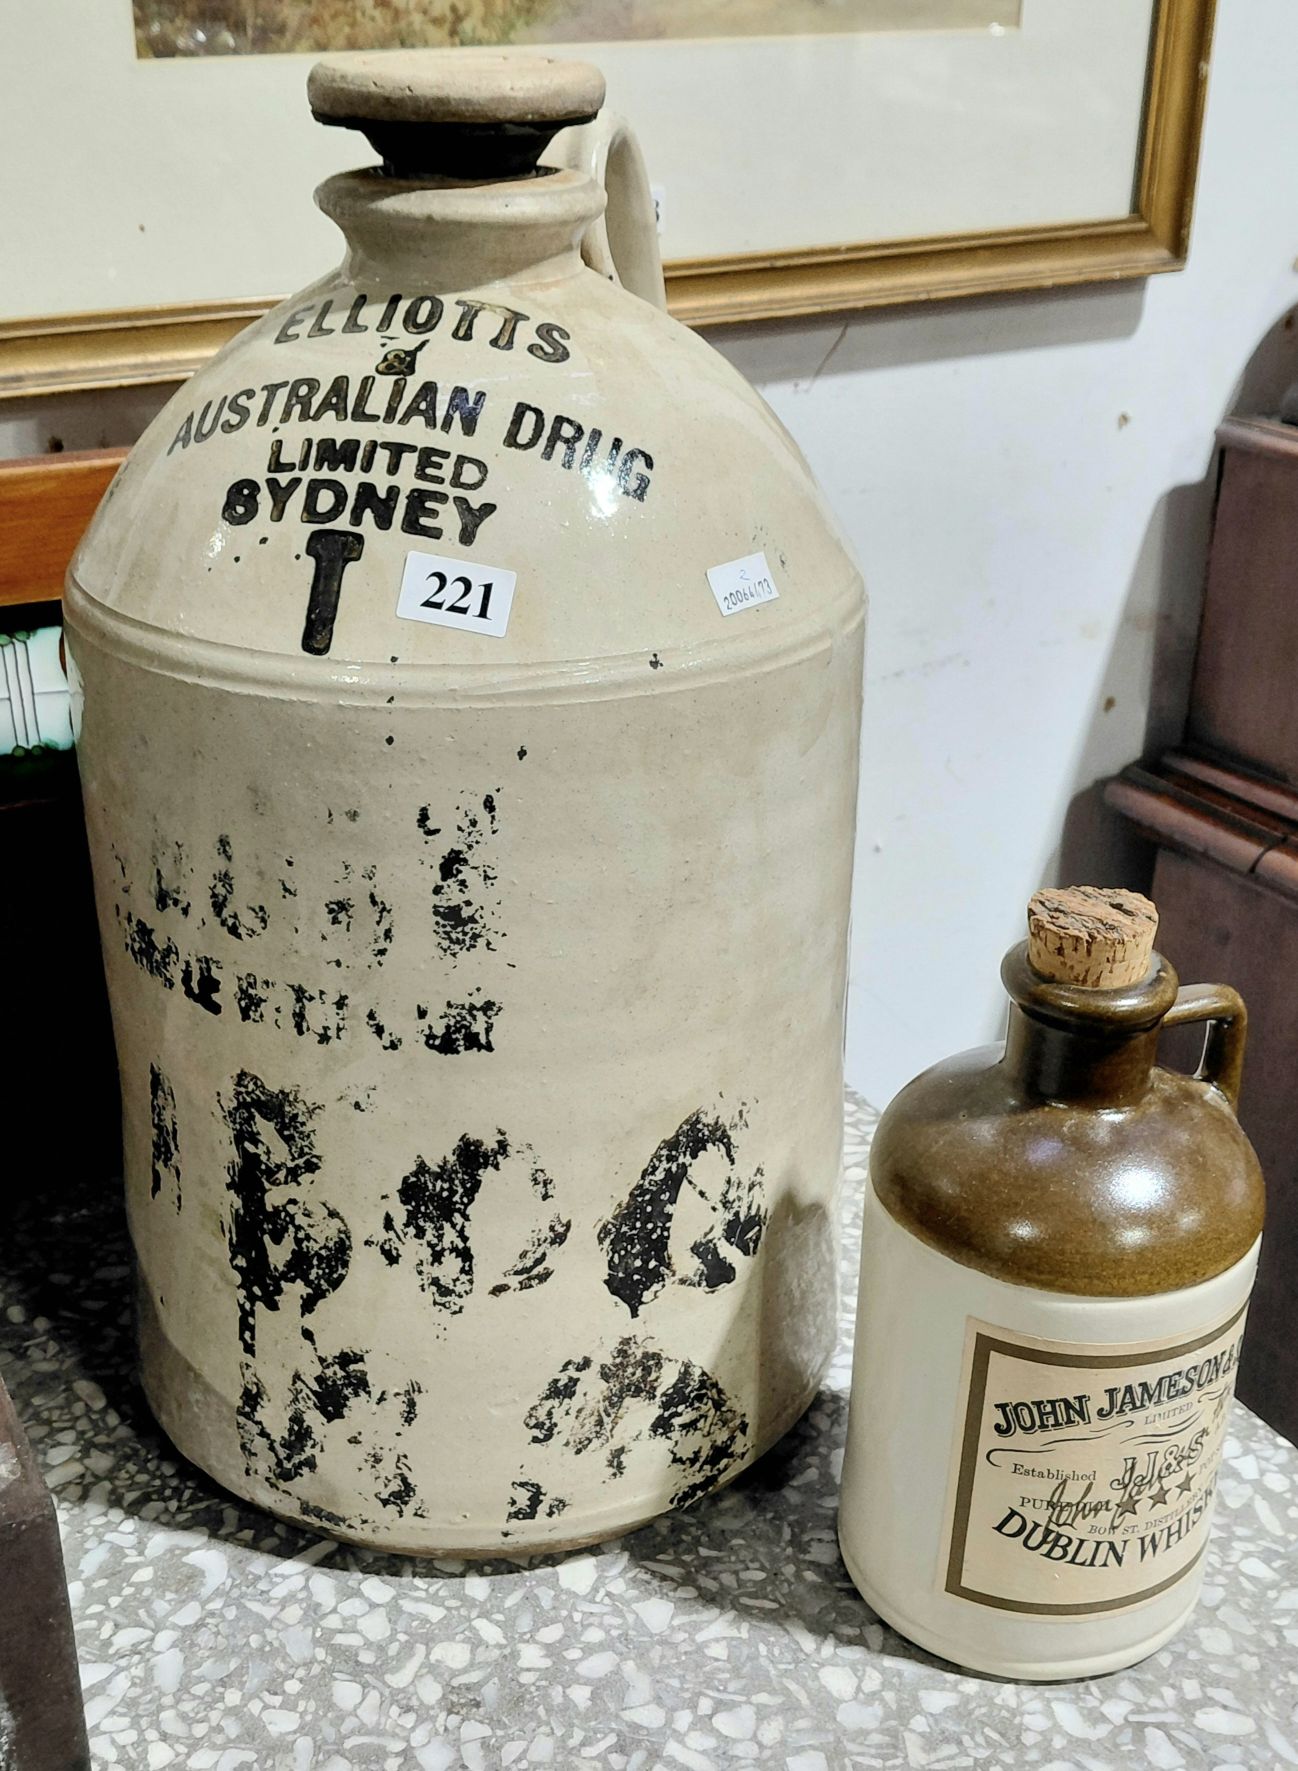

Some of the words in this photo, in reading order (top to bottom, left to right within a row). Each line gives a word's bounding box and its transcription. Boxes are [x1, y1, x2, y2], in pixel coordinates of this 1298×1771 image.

[274, 294, 570, 363] ELLIOTTS
[167, 375, 487, 456] AUSTRALIAN
[503, 401, 655, 502] DRUG
[267, 437, 489, 491] LIMITED
[222, 477, 497, 546] SYDNEY
[419, 570, 497, 621] 221
[993, 1395, 1091, 1438] JOHN
[1097, 1351, 1227, 1421] JAMESON
[1144, 1401, 1194, 1425] LIMITED
[1011, 1462, 1097, 1481] Established
[992, 1506, 1128, 1567] DUBLIN
